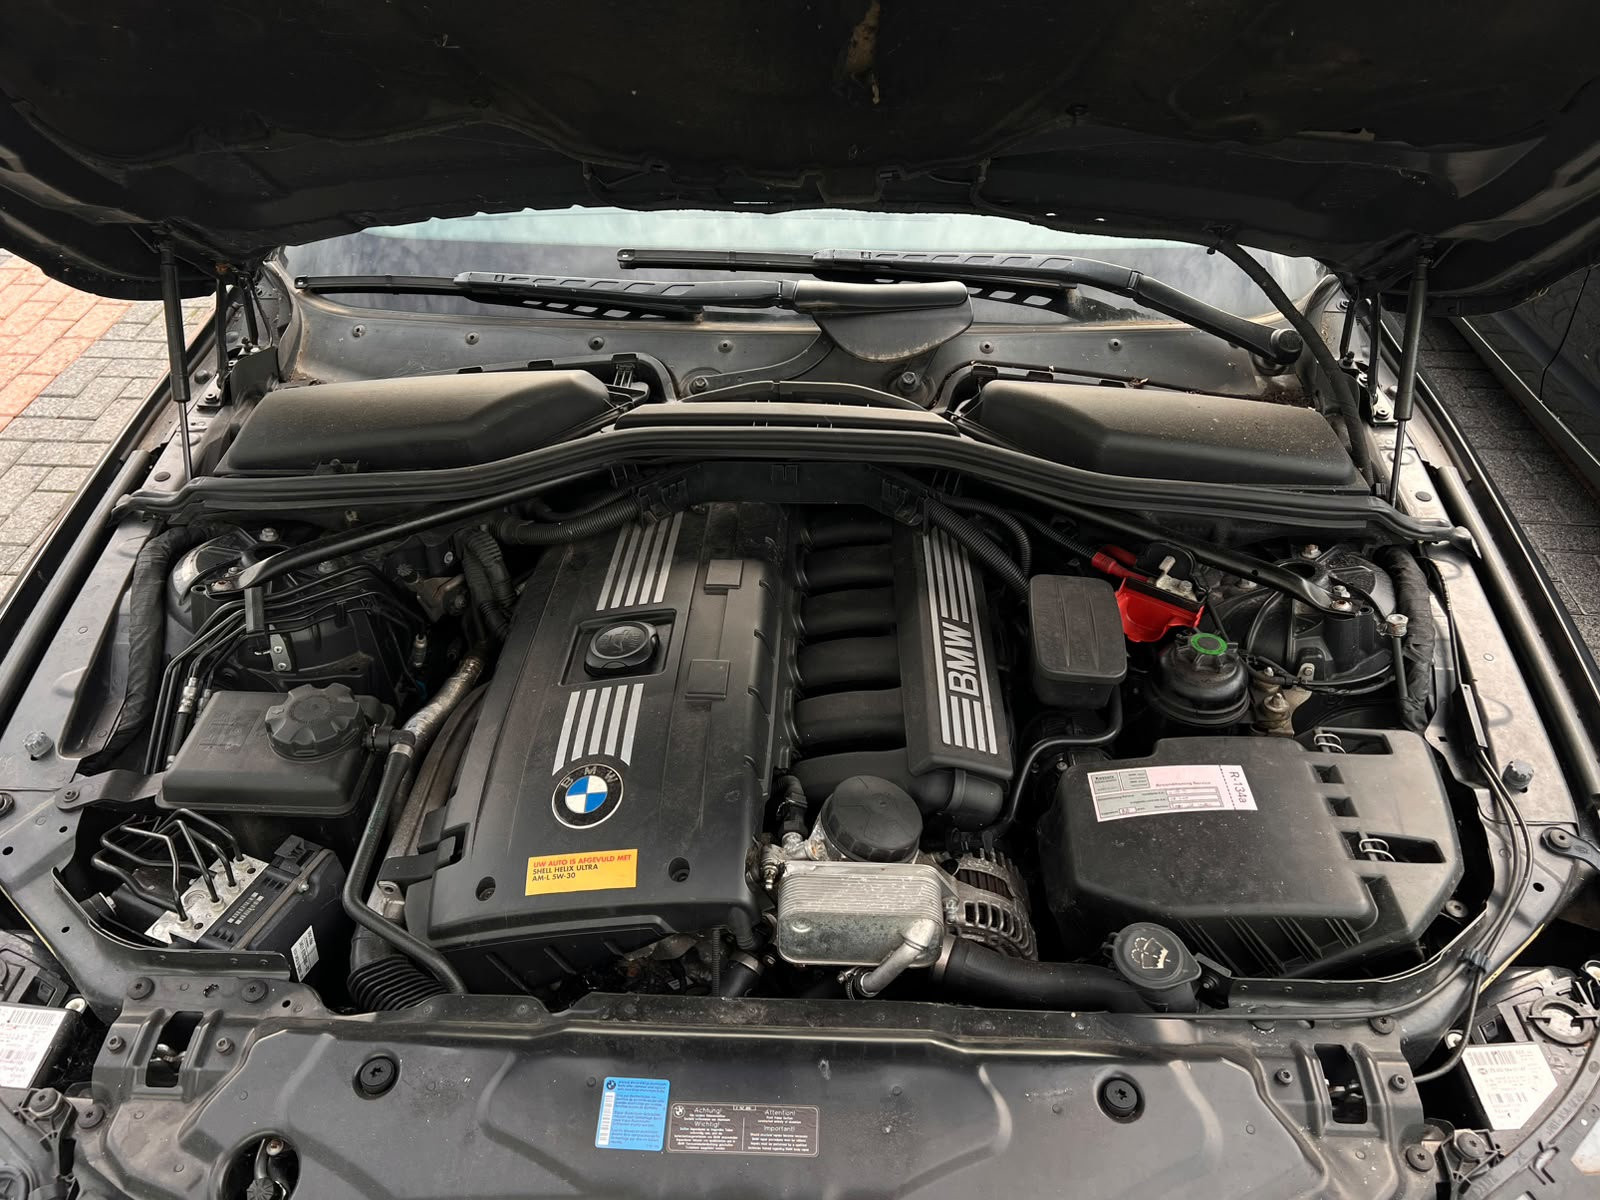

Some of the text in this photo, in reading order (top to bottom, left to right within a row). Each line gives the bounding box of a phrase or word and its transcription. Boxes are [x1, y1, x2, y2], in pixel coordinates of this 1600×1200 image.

[942, 621, 980, 697] BMW
[561, 766, 618, 788] BMW
[1229, 771, 1247, 803] R-134a
[547, 859, 568, 867] AUTO
[578, 855, 615, 864] AFGEVULD
[616, 854, 632, 862] MET
[532, 867, 552, 875] SHELL
[554, 865, 574, 873] HELIX
[532, 872, 576, 882] AM-L 5W-30
[694, 1107, 723, 1115] Achtung!
